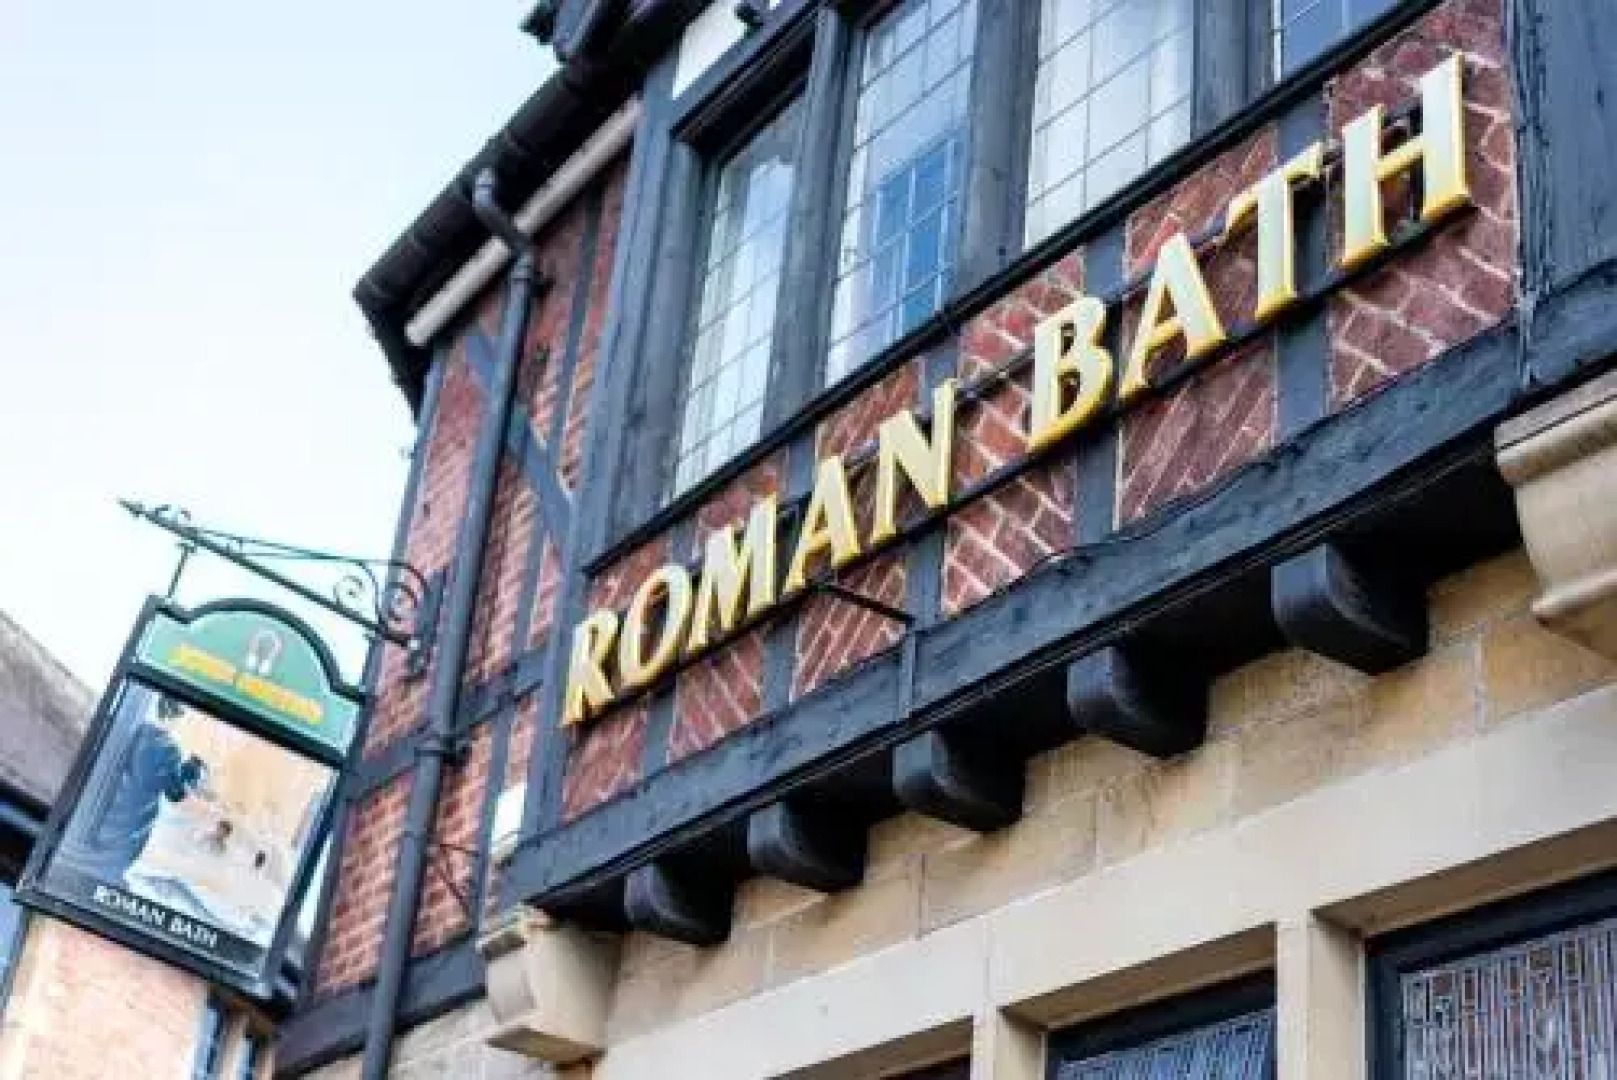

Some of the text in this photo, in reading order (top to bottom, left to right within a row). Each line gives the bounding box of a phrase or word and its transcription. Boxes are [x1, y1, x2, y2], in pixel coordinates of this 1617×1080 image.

[562, 52, 1470, 727] ROMAN BATH
[93, 885, 166, 926] ROMAN
